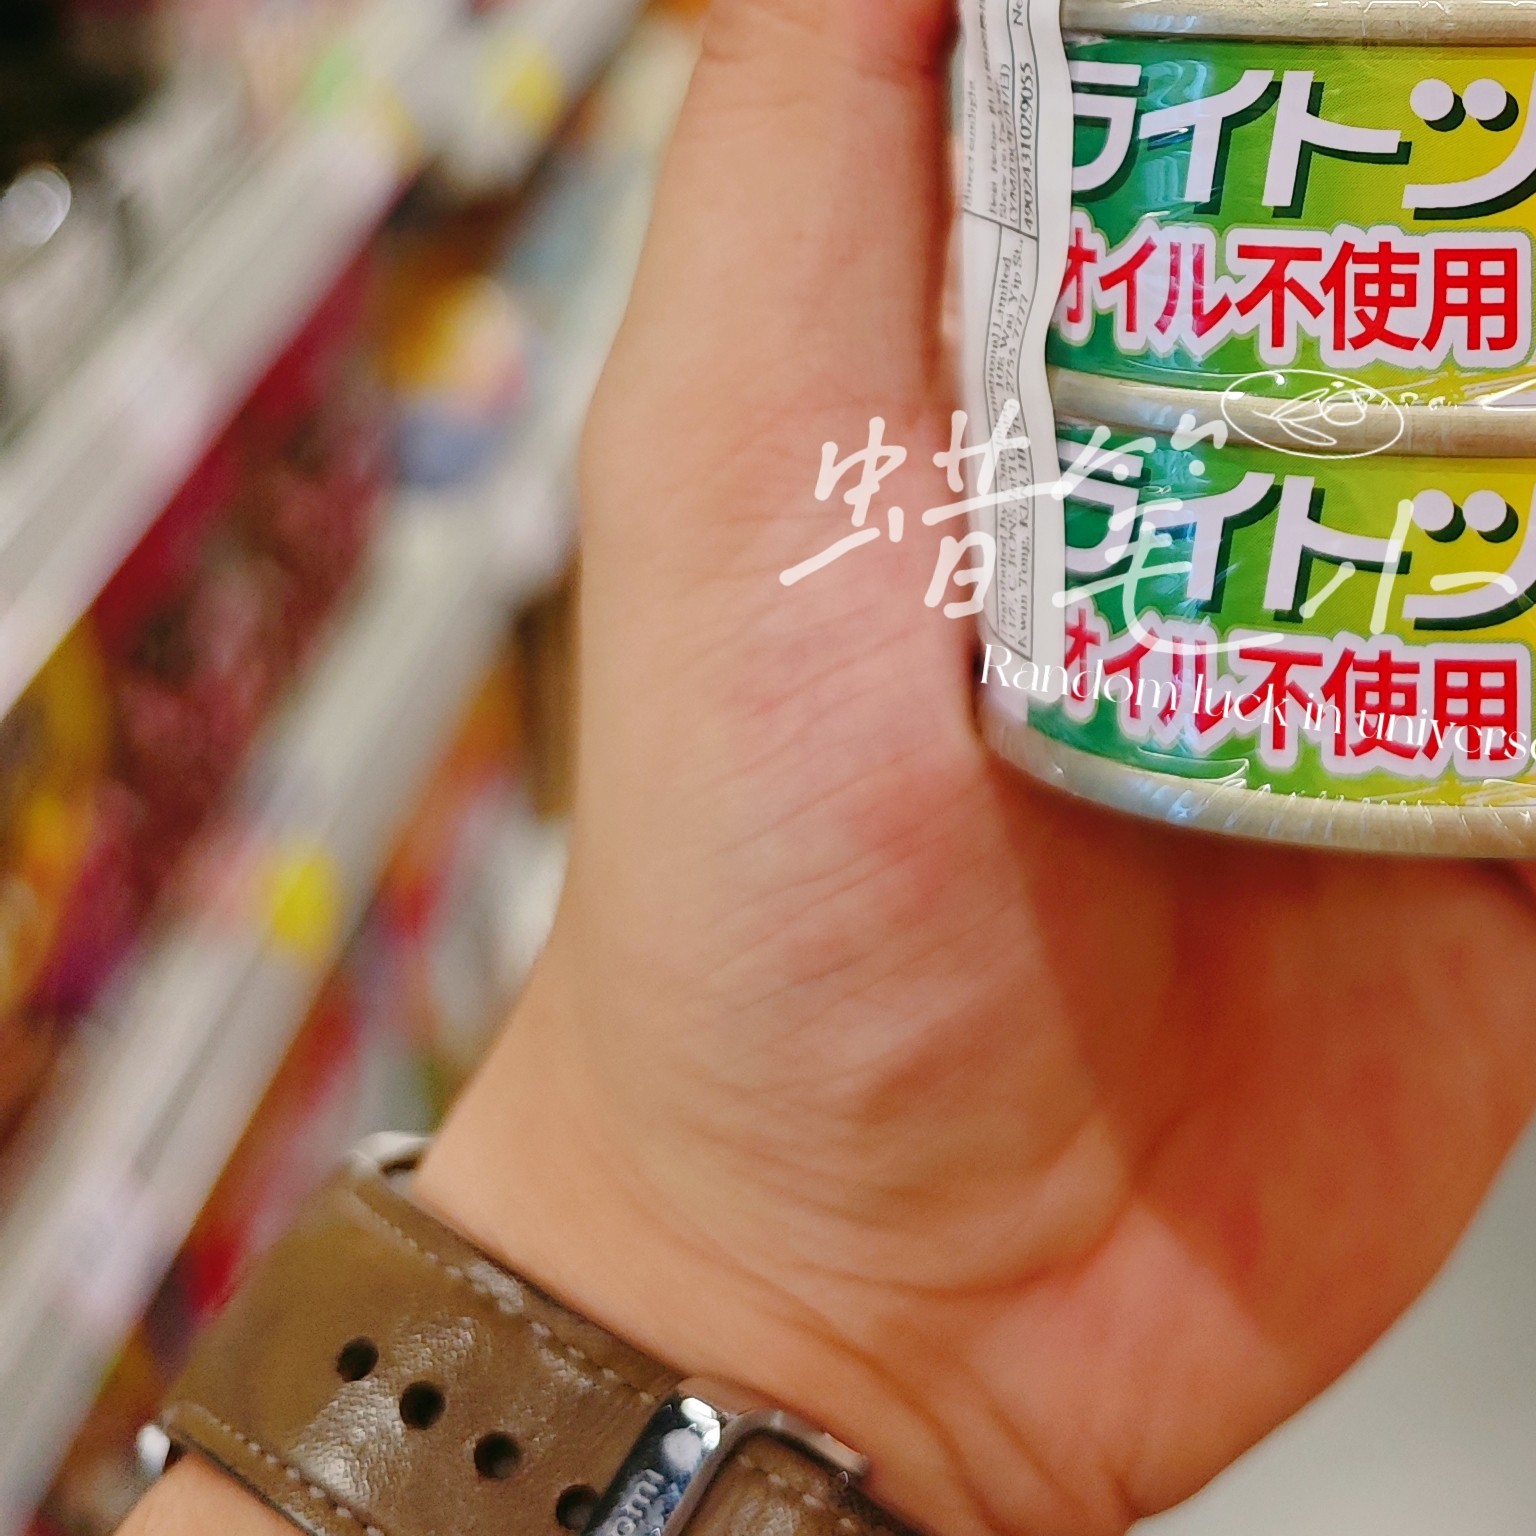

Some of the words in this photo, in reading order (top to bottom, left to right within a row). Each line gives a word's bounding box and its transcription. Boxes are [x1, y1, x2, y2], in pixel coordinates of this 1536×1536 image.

[1056, 227, 1518, 352] オイル不使用
